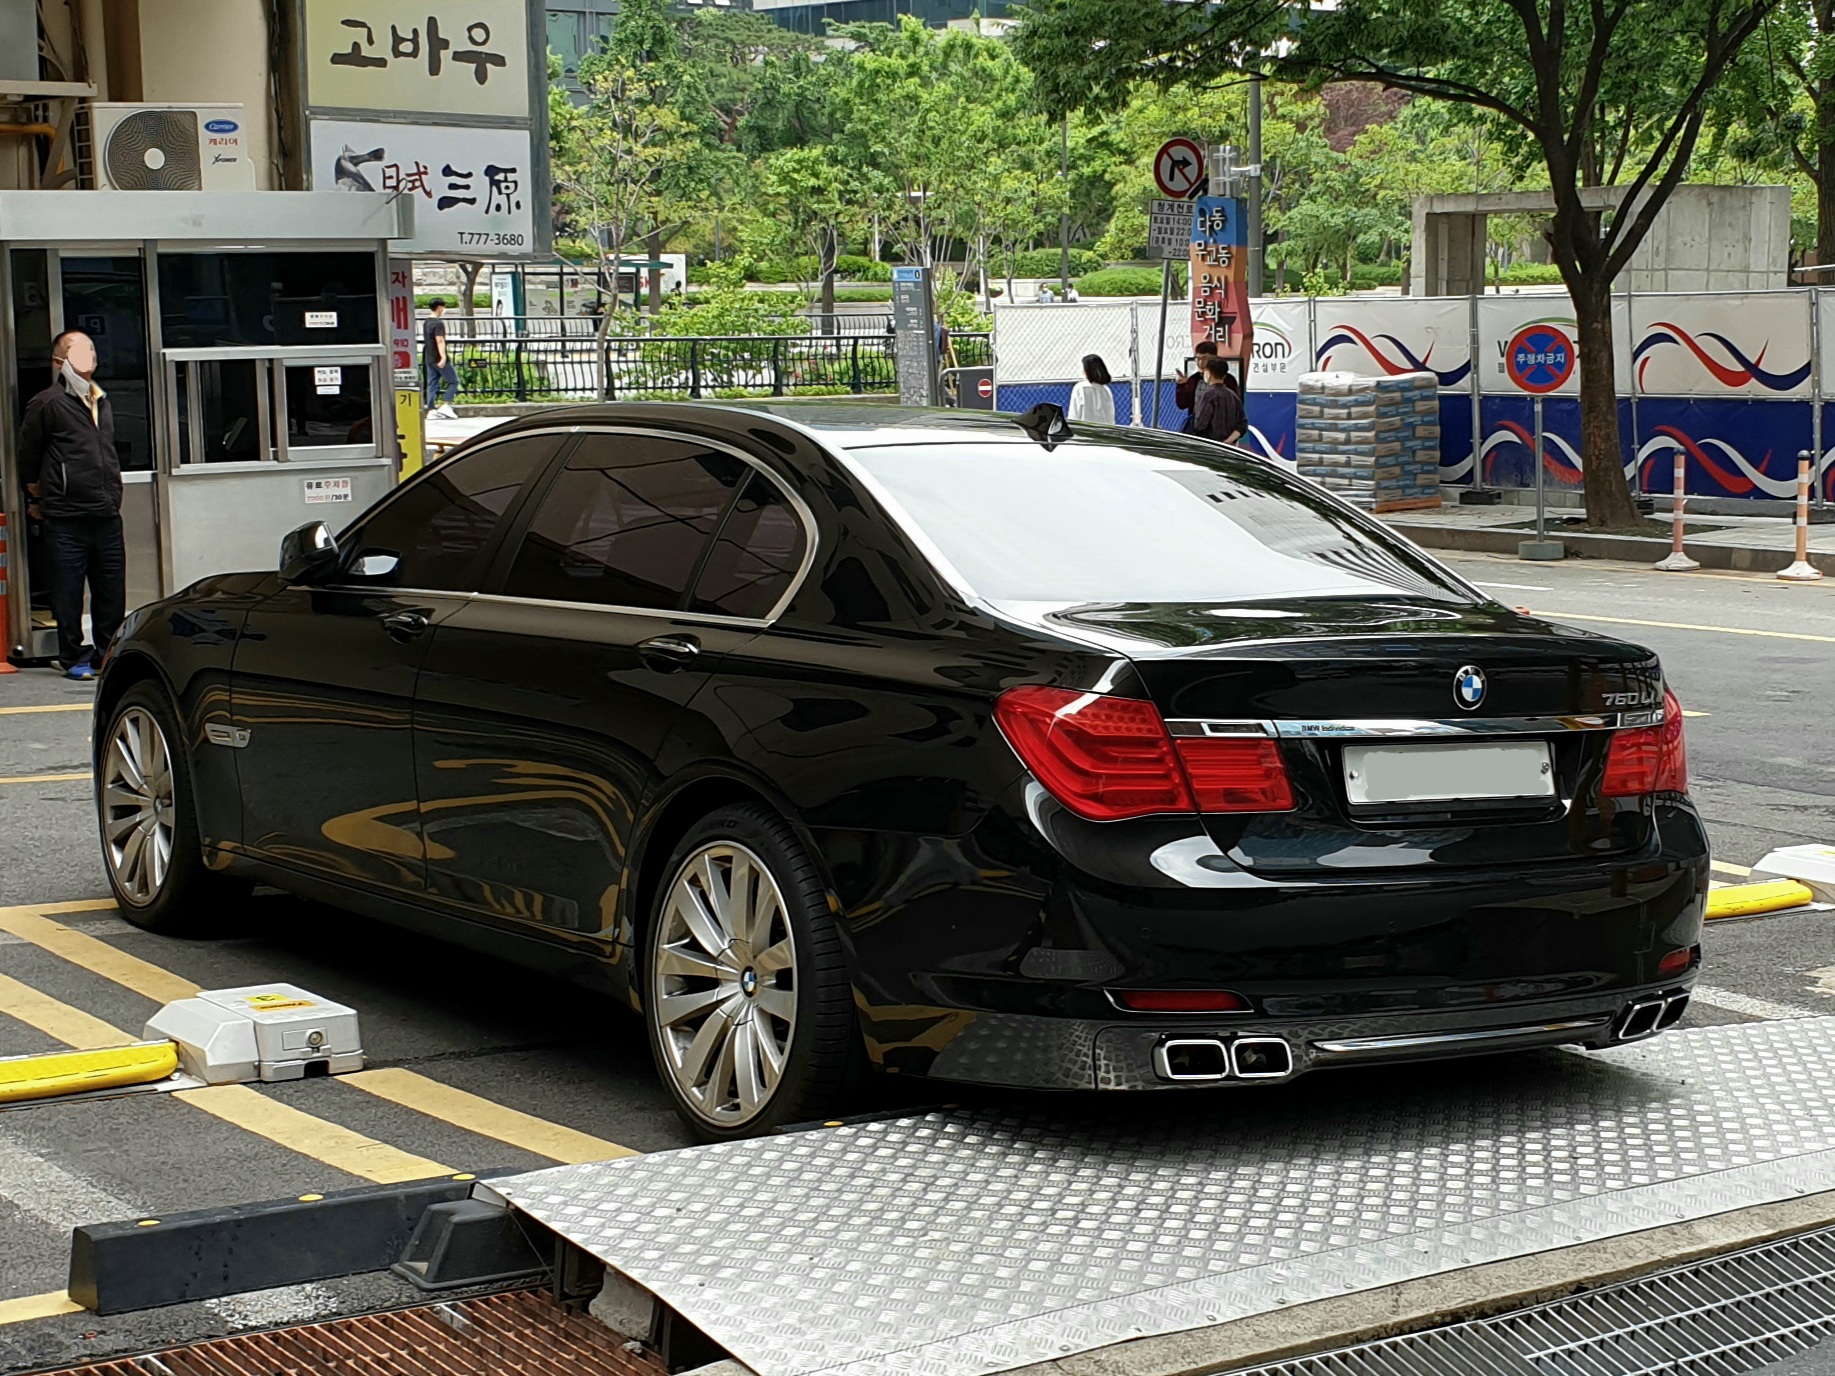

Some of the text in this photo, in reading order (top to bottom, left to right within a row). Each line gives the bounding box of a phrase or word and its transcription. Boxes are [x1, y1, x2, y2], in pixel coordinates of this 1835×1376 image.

[330, 15, 507, 86] 고바우
[381, 160, 522, 215] 日式 三原
[1157, 201, 1194, 214] 청계천로
[1197, 207, 1226, 237] 다동
[457, 231, 524, 246] T.777-3680
[1194, 240, 1232, 267] 무교동
[1200, 273, 1225, 299] 음식
[1193, 298, 1221, 323] 문화
[1203, 323, 1229, 347] 거리
[1516, 352, 1565, 365] 주정차금지
